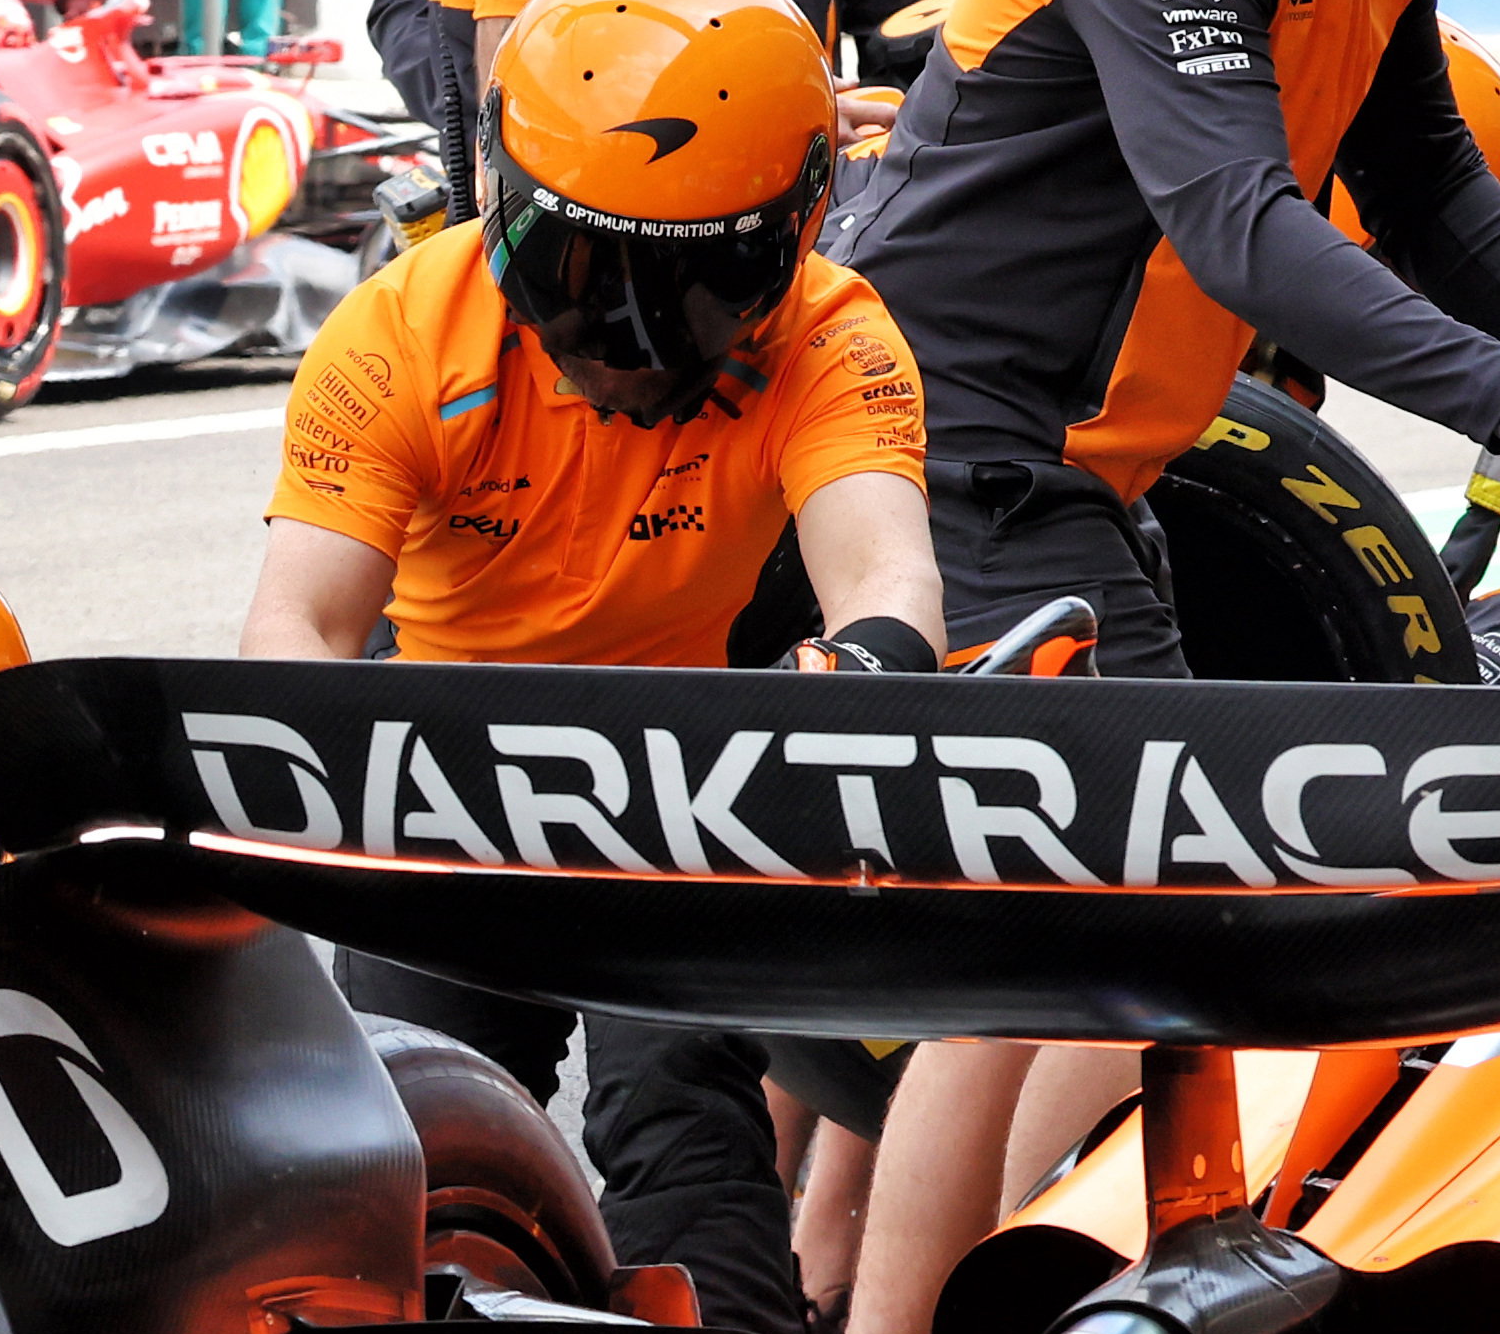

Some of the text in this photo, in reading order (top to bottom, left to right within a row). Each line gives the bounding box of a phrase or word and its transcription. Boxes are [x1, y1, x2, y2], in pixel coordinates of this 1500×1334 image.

[1162, 10, 1238, 25] vmware
[1168, 26, 1243, 54] FxPro
[533, 188, 558, 210] ON
[566, 203, 636, 234] OPTIMUM
[641, 221, 725, 238] NUTRITION
[320, 371, 367, 421] Hilton
[345, 348, 395, 399] workday
[295, 412, 356, 453] alteryx
[630, 506, 705, 540] OKX
[1281, 465, 1442, 684] ZER
